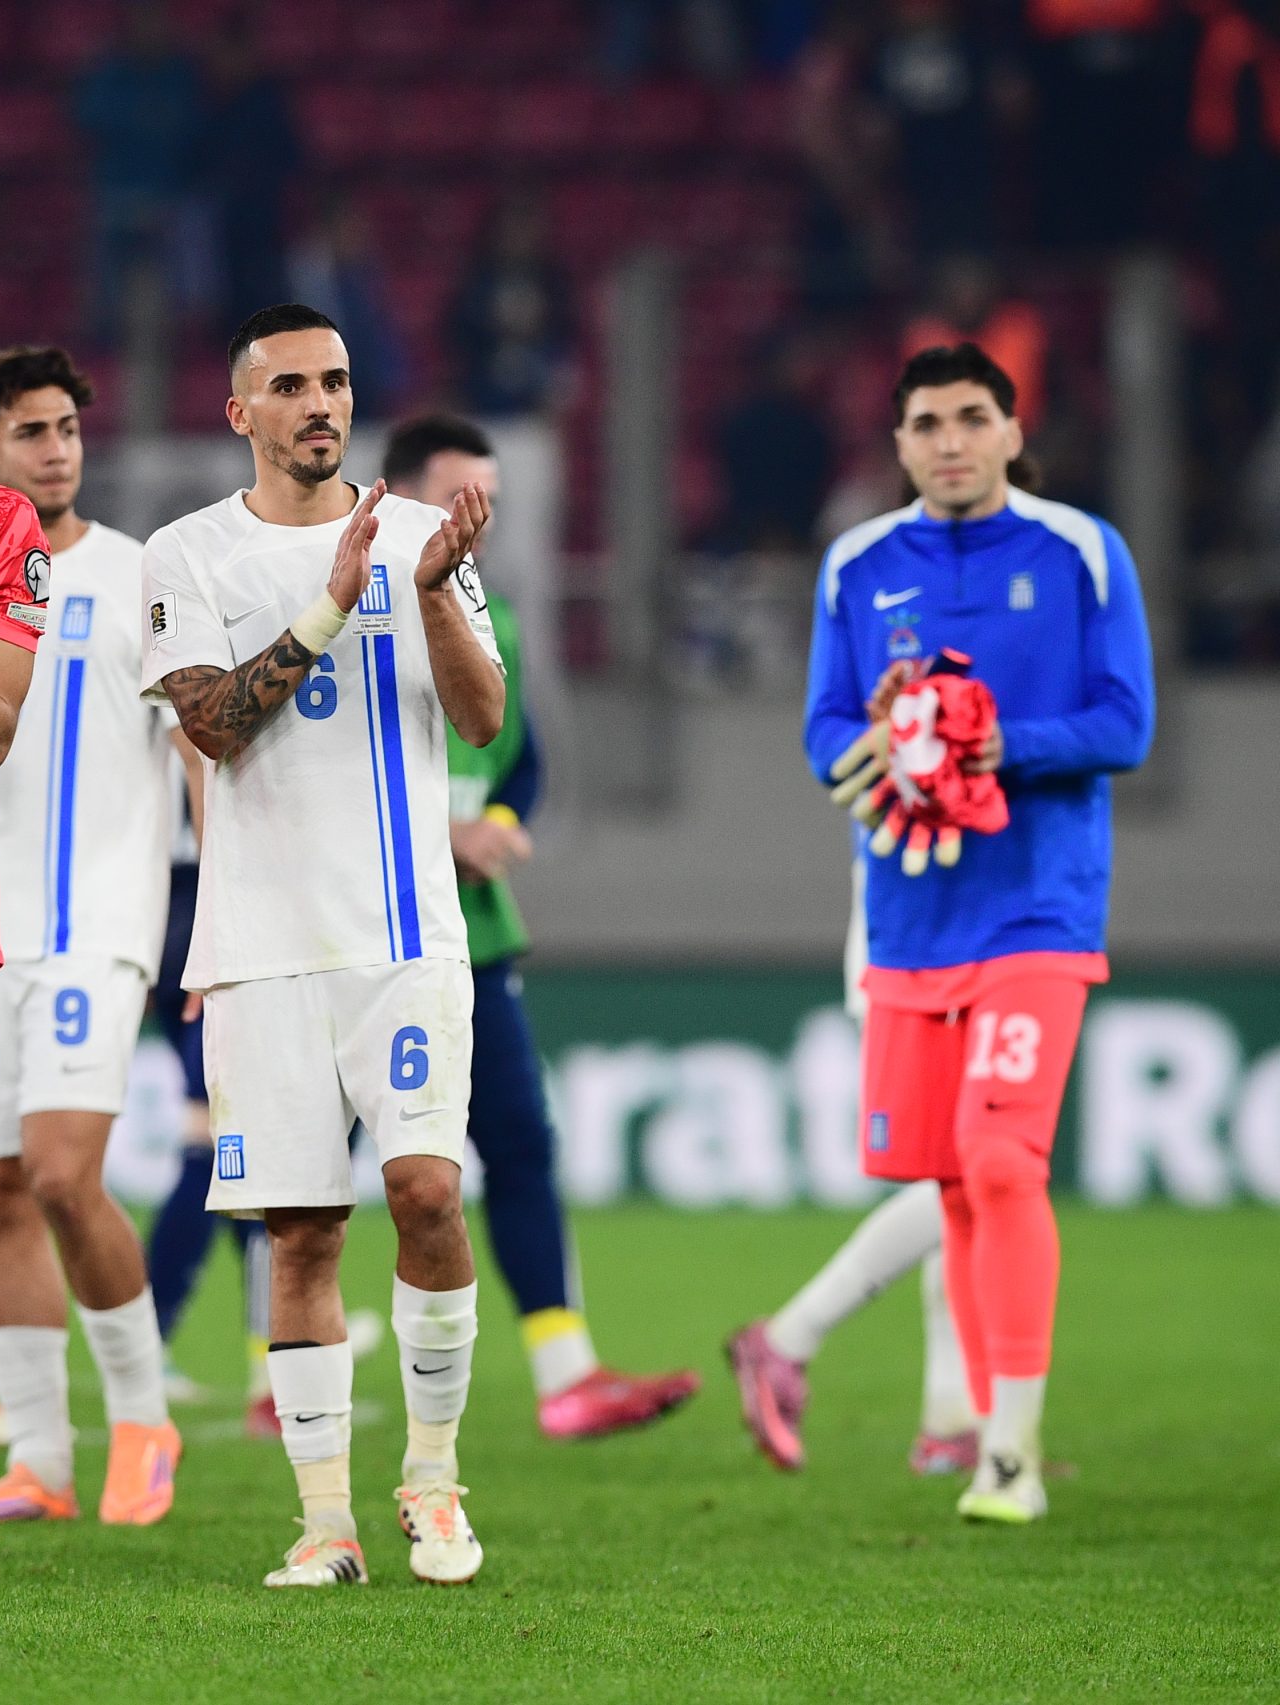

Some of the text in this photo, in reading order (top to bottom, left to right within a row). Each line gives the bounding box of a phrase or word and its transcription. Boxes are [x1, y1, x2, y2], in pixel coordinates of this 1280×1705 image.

[9, 610, 47, 623] FOUNDATIO
[296, 653, 336, 719] 6
[55, 989, 89, 1045] 9
[967, 1013, 1041, 1082] 13
[390, 1026, 428, 1090] 6
